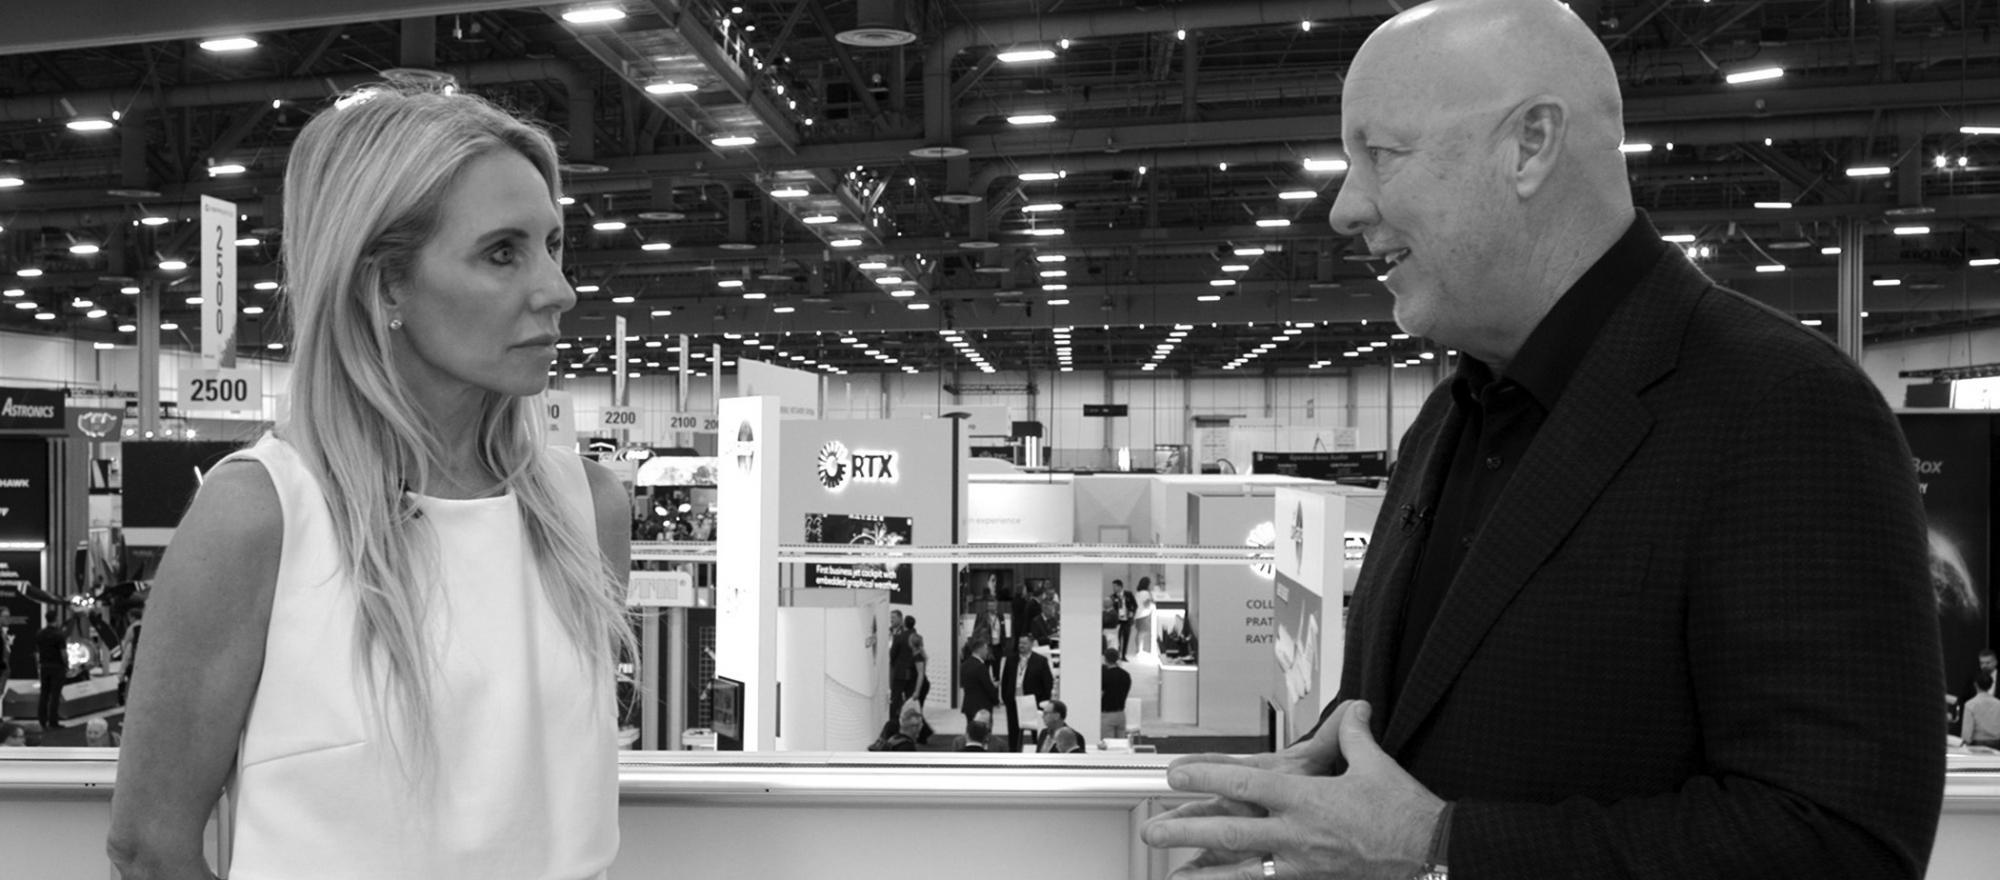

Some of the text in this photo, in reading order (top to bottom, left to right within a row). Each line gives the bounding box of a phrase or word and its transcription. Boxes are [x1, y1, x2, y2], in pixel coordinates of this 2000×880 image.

[215, 225, 223, 334] 2500
[190, 378, 247, 401] 2500
[605, 411, 636, 424] 2200
[670, 416, 697, 428] 2100
[851, 454, 892, 478] RTX
